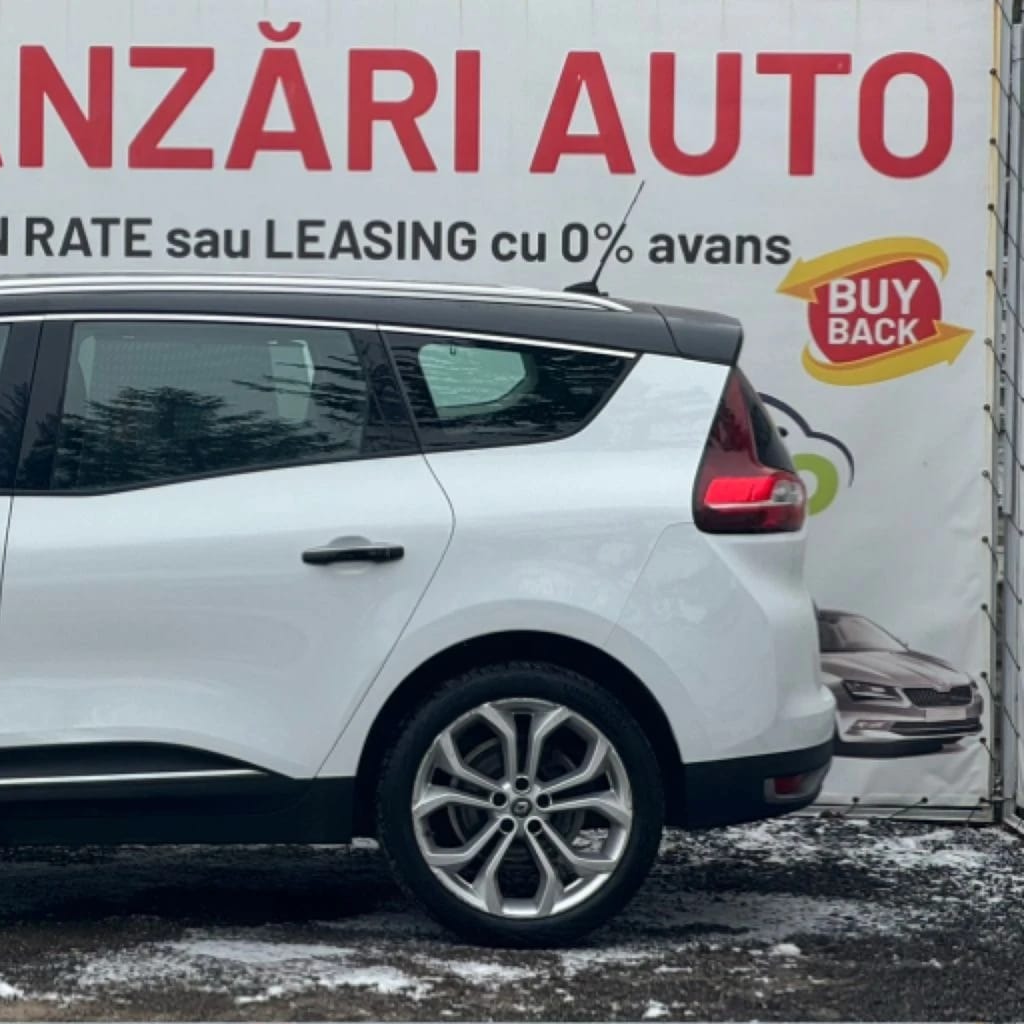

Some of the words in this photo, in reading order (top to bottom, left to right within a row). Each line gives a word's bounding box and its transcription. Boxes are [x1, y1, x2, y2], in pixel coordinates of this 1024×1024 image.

[530, 51, 954, 179] AUTO
[25, 216, 153, 258] RATE
[166, 228, 250, 259] sau
[265, 219, 477, 262] LEASING
[491, 231, 547, 263] cu
[561, 221, 634, 263] 0%
[648, 233, 791, 265] avans
[829, 278, 920, 315] BUY
[829, 317, 918, 345] BACK
